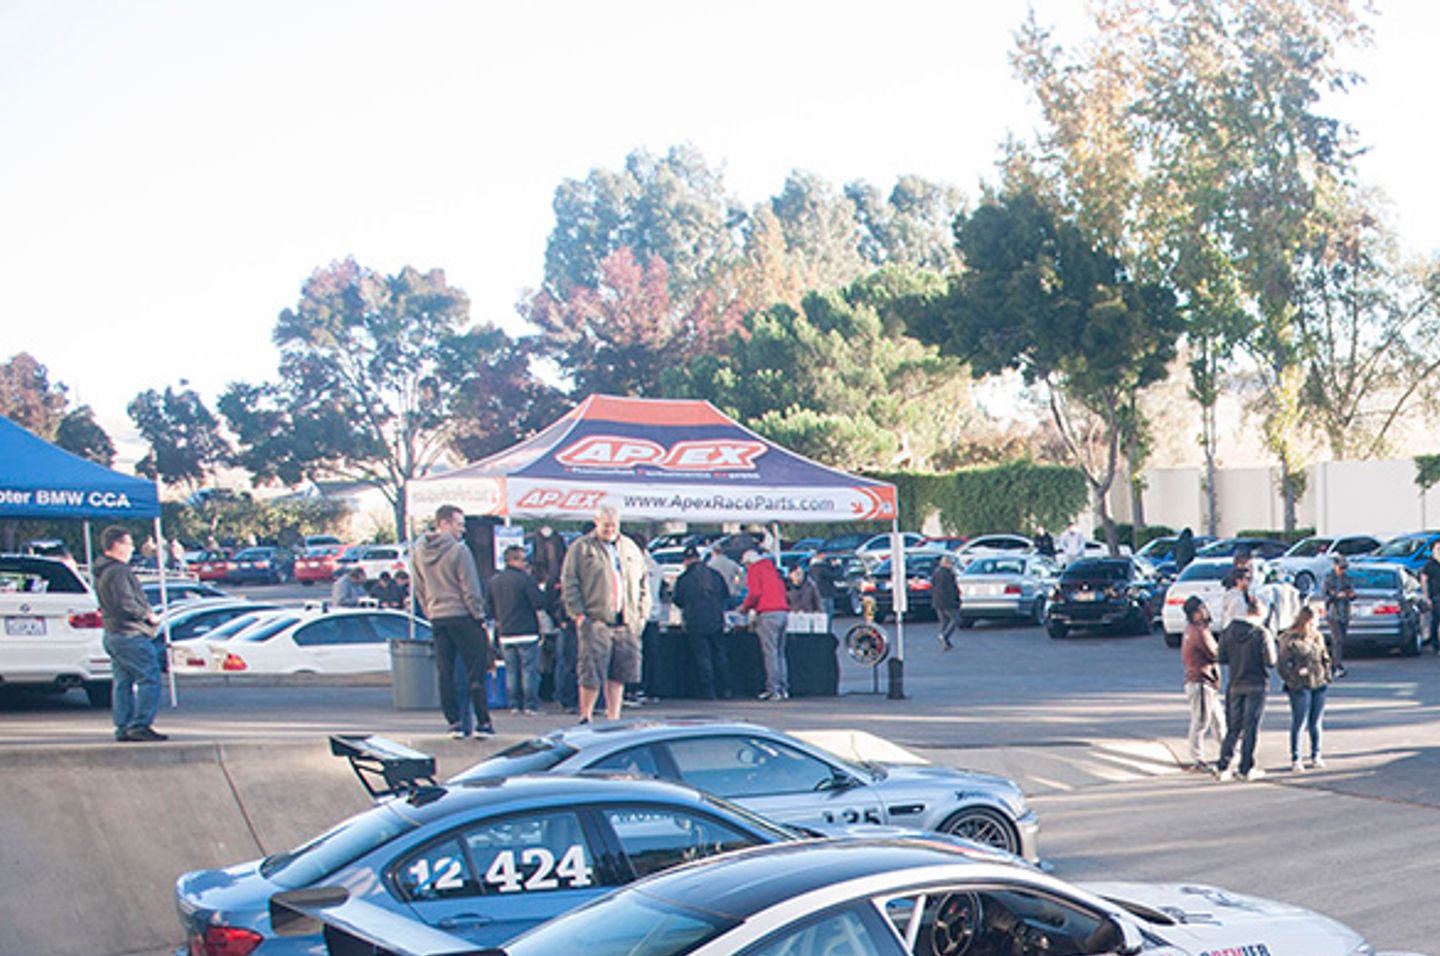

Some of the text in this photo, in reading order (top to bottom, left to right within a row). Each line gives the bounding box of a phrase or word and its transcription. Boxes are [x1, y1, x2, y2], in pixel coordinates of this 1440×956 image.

[35, 489, 84, 506] BMW
[87, 491, 132, 509] CCA
[624, 494, 836, 513] www.ApexRaceParts.com
[485, 844, 593, 893] 424
